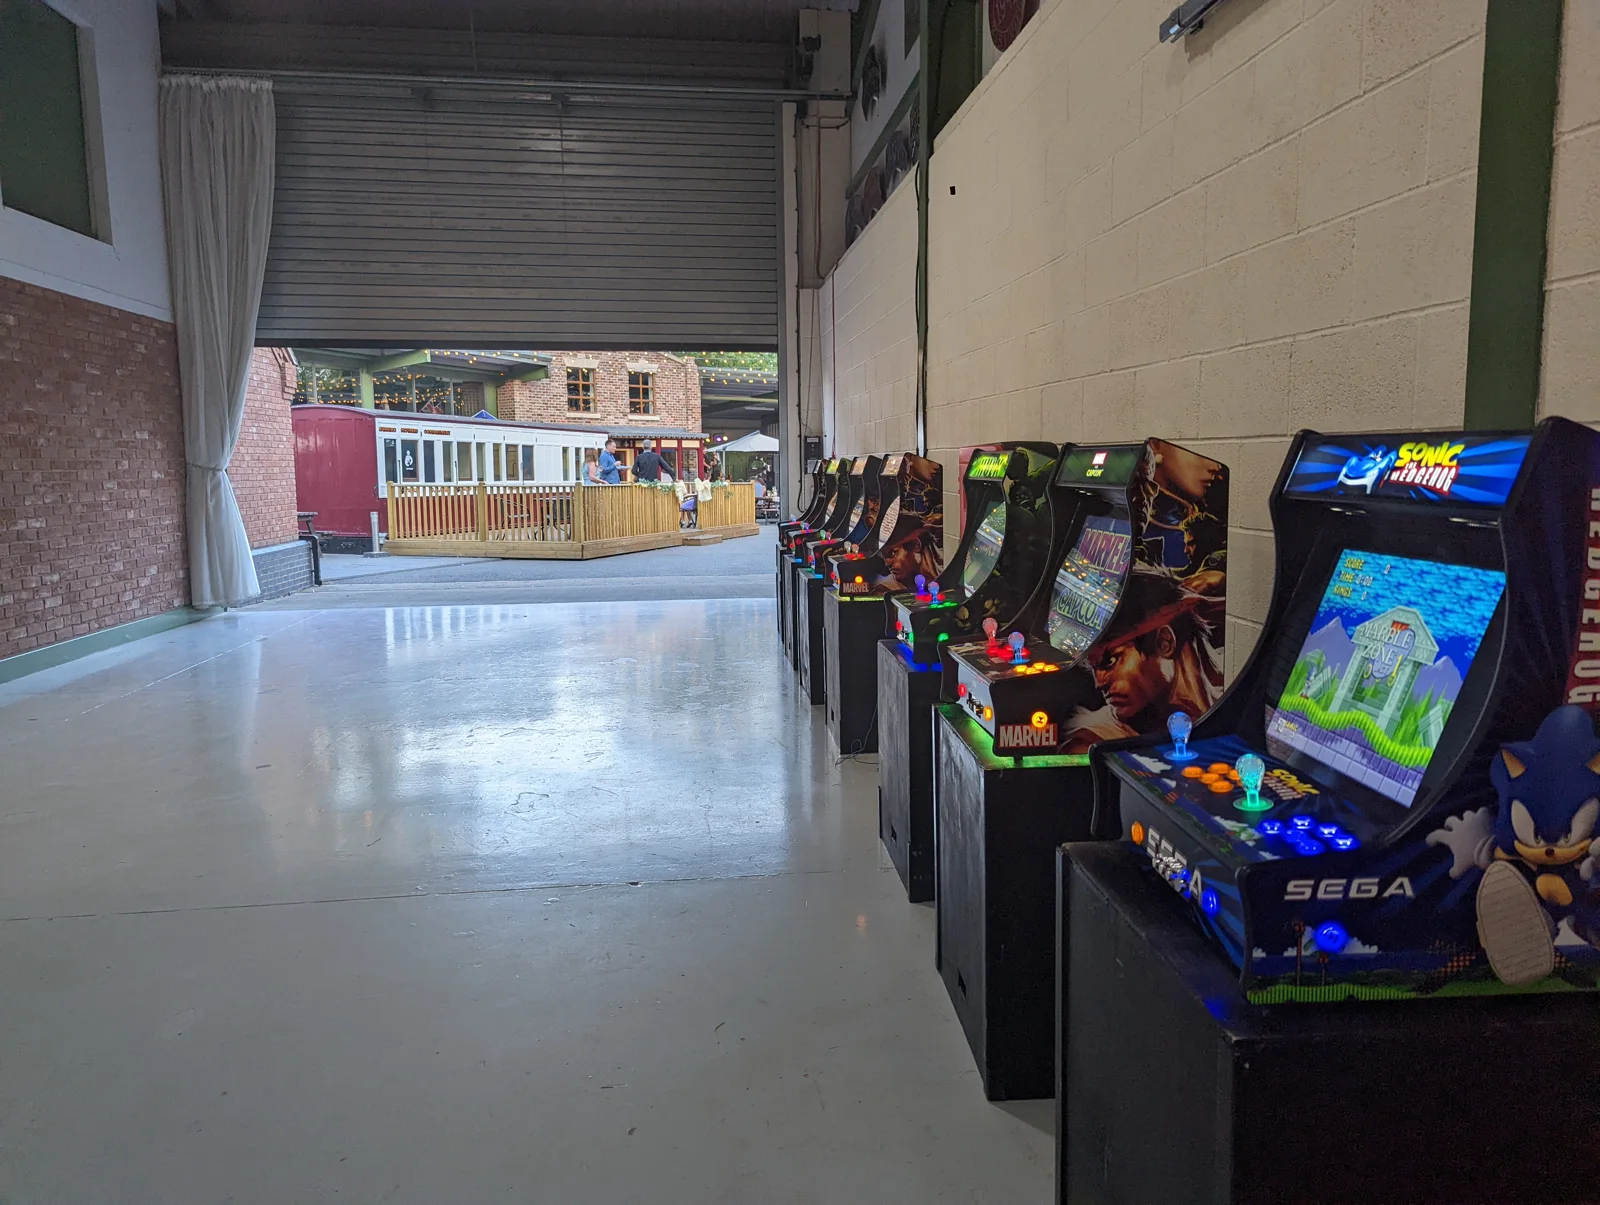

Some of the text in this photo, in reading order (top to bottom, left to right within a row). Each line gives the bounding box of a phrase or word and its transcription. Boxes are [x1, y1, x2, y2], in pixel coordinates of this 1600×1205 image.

[1394, 441, 1465, 467] SONIC
[1405, 461, 1417, 470] THE
[1390, 466, 1456, 492] HEDGEHOG
[1076, 528, 1131, 575] MARVEL
[842, 582, 869, 593] MARVEL
[1340, 572, 1354, 583] TIME
[1057, 588, 1108, 630] CAPCOM
[1360, 621, 1413, 651] MARBLE
[1361, 643, 1398, 666] ZONE
[999, 724, 1057, 748] MARVEL
[1284, 877, 1415, 900] SEGA
